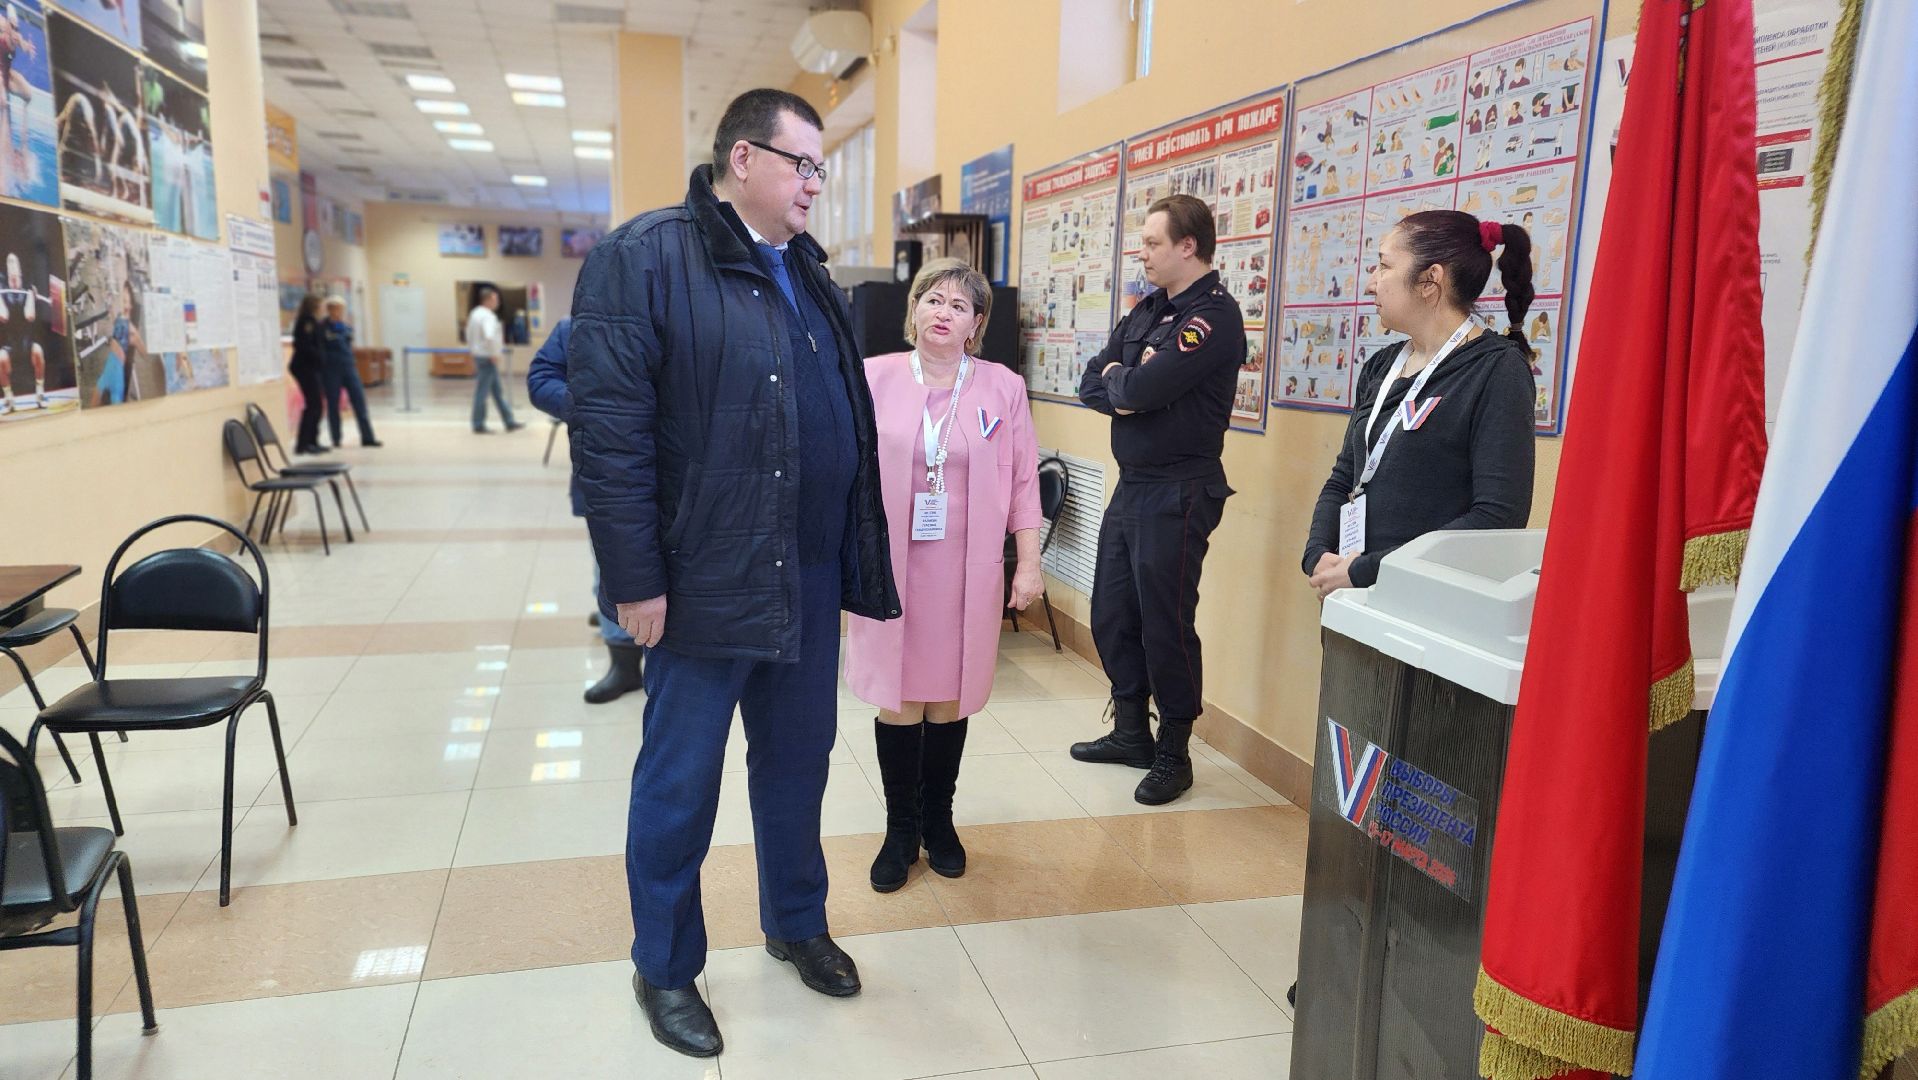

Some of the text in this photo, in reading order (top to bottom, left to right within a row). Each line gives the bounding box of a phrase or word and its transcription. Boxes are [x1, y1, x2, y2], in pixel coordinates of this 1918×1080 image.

[1133, 142, 1153, 164] УМЕЙ
[1156, 126, 1211, 160] ДЕЙСТВОВАТЬ
[1214, 118, 1234, 139] ПРИ
[1237, 104, 1279, 132] ПОЖАРЕ
[1391, 758, 1457, 805] ВЫБОРЫ
[1374, 803, 1431, 845] РОССИИ
[1380, 781, 1476, 847] ПРЕЗИДЕНТА
